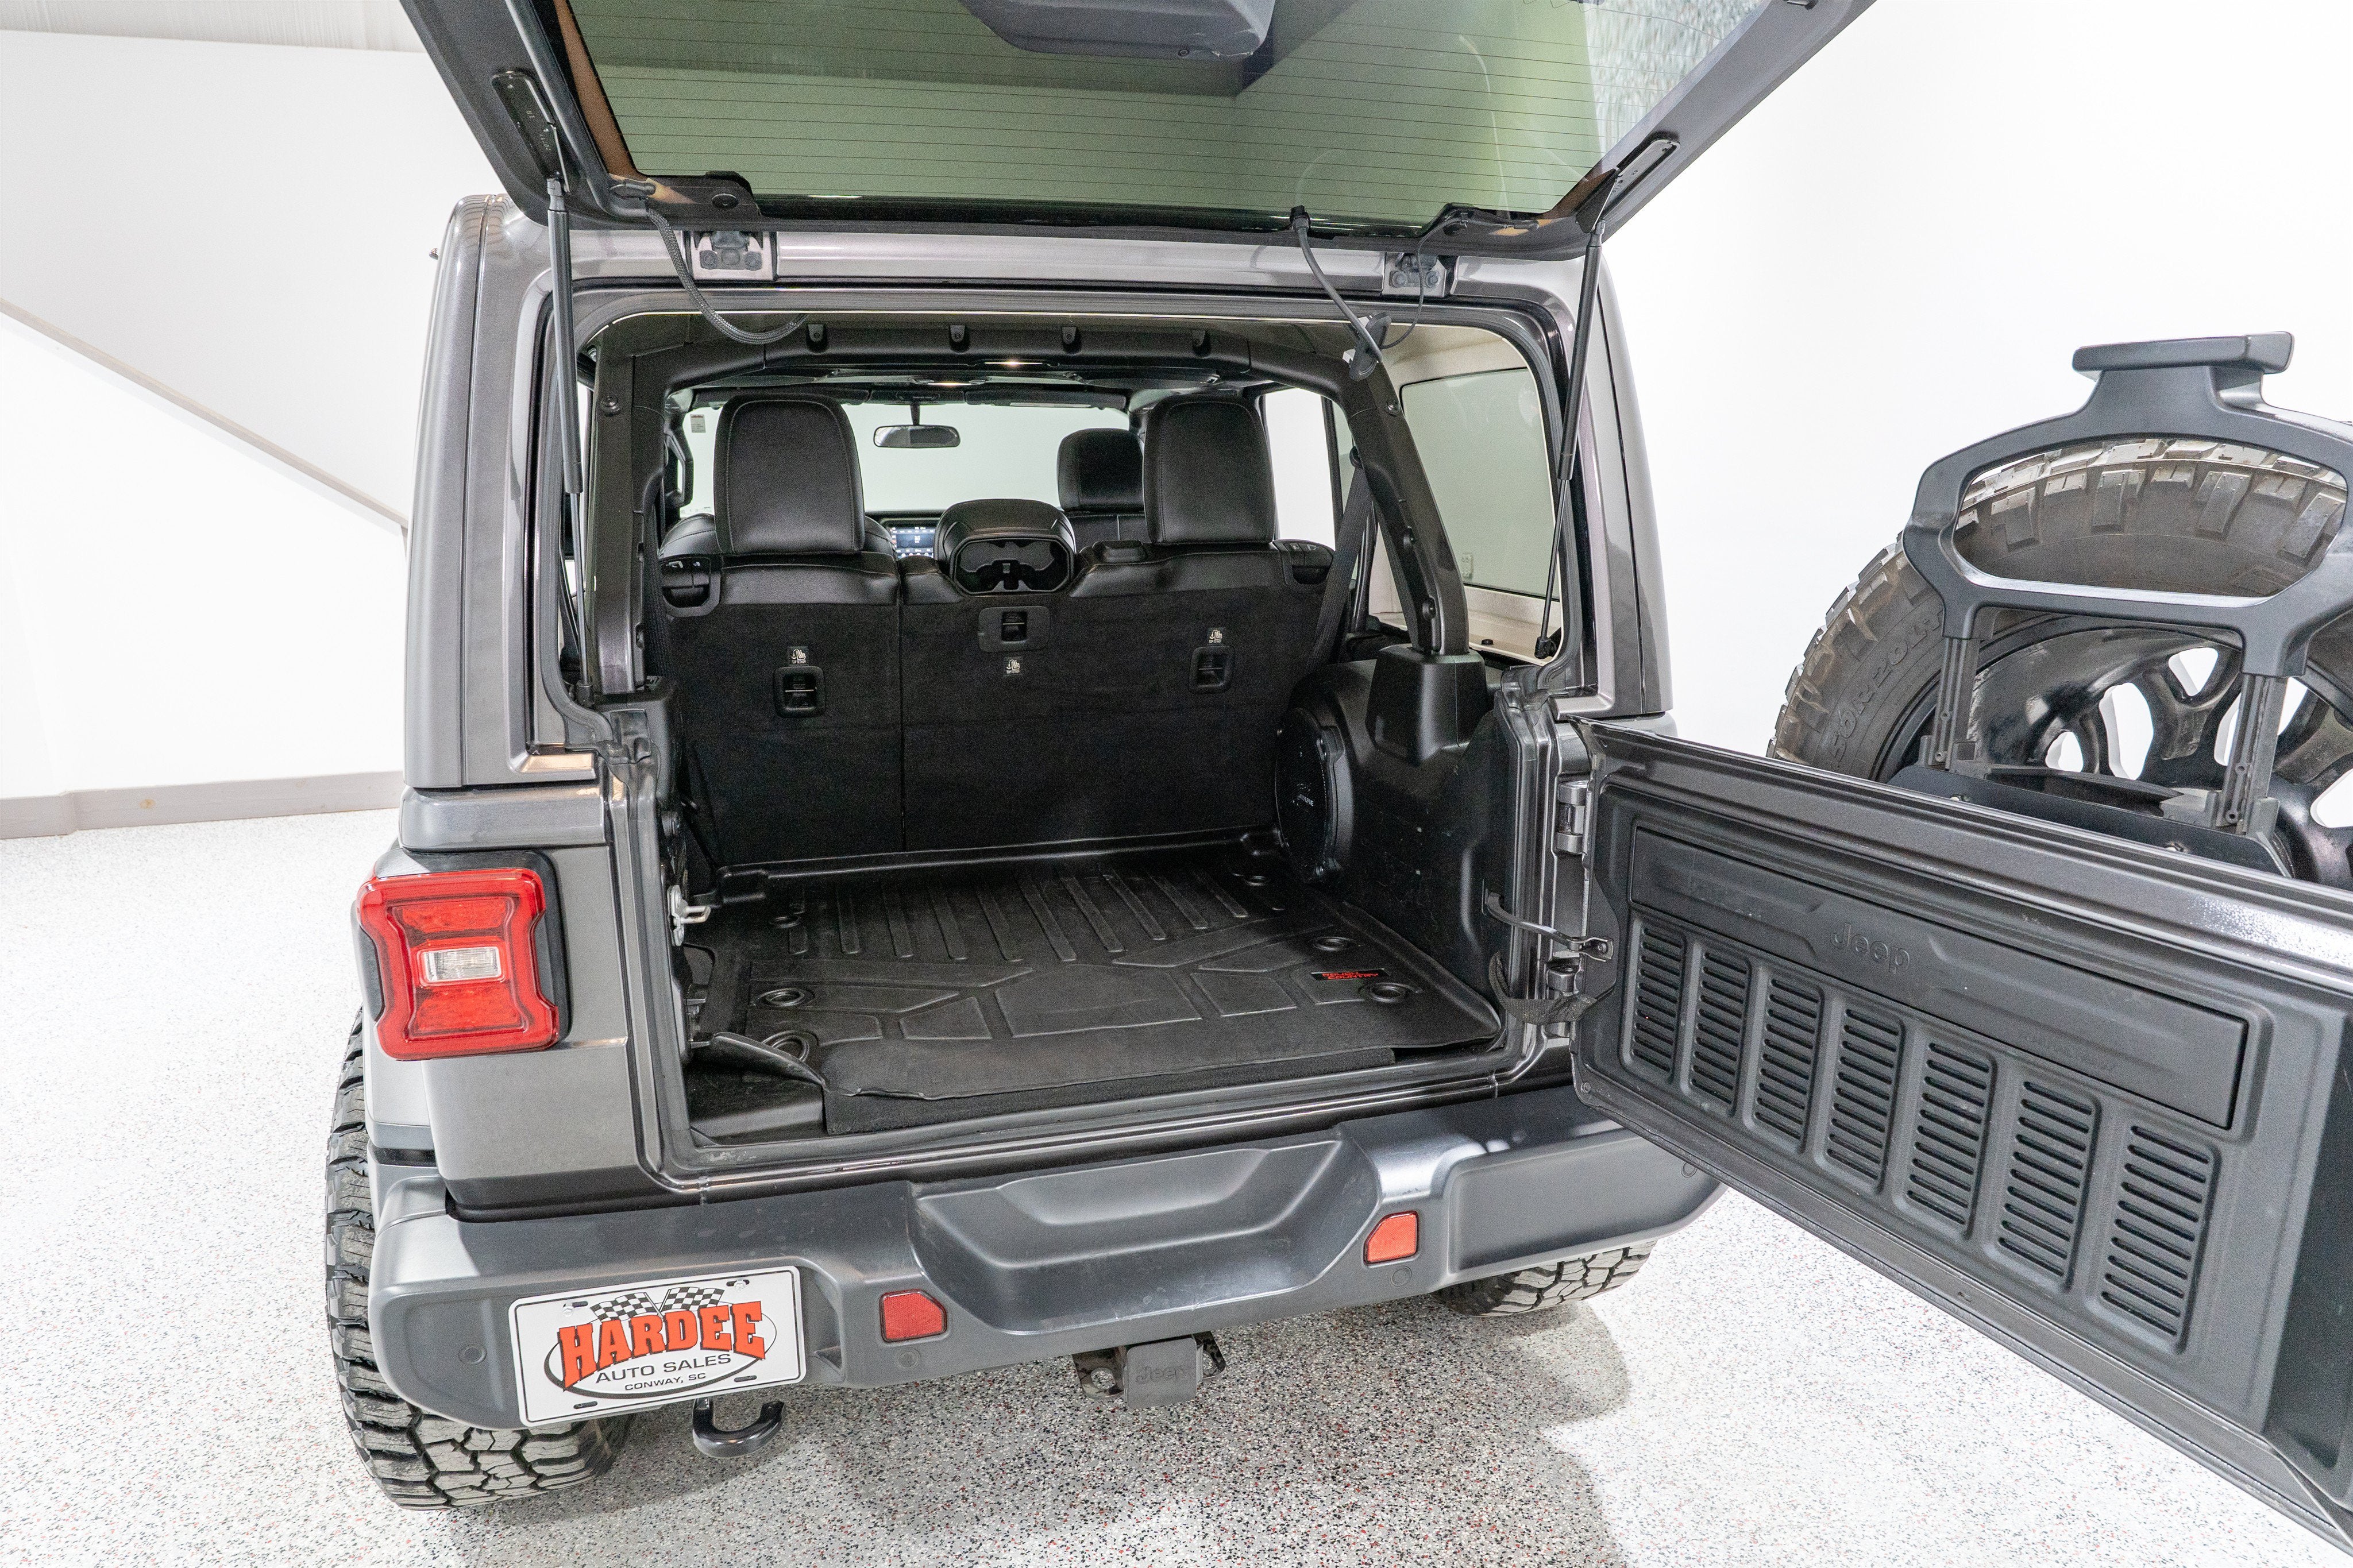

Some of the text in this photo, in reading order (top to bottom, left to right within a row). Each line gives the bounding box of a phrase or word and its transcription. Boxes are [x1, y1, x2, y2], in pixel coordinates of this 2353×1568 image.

[1830, 922, 1910, 975] Jeep
[557, 1301, 766, 1391] HARDEE
[596, 1353, 731, 1384] AUTO SALES
[624, 1373, 707, 1391] CONWAY, SC
